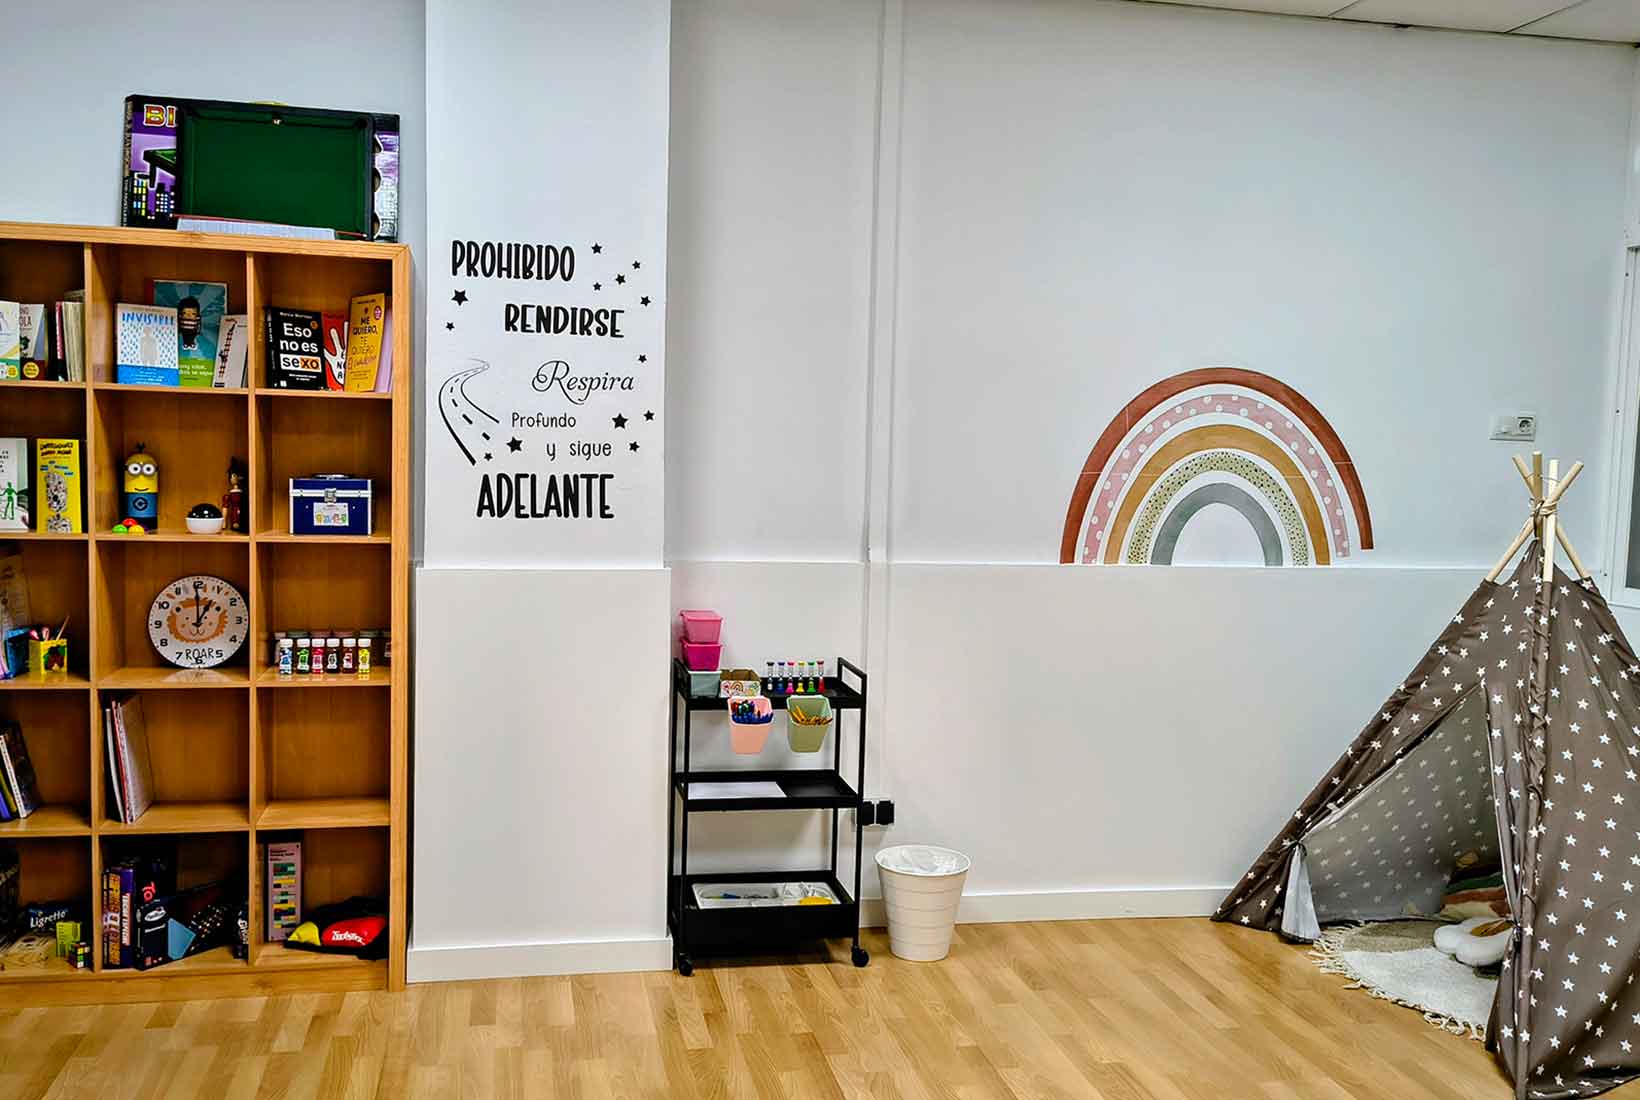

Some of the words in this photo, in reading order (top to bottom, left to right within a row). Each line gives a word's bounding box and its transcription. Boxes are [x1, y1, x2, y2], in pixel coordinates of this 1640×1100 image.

[451, 240, 575, 282] PROHIBIDO
[283, 322, 312, 338] Eso
[505, 304, 625, 338] RENDIRSE
[279, 340, 299, 352] no
[301, 341, 319, 353] es
[282, 357, 320, 370] sexo
[532, 361, 634, 405] Respira
[511, 412, 577, 428] Profundo
[546, 443, 556, 461] y
[569, 440, 612, 461] sigue
[476, 473, 615, 519] ADELANTE
[30, 909, 67, 929] Ligretto
